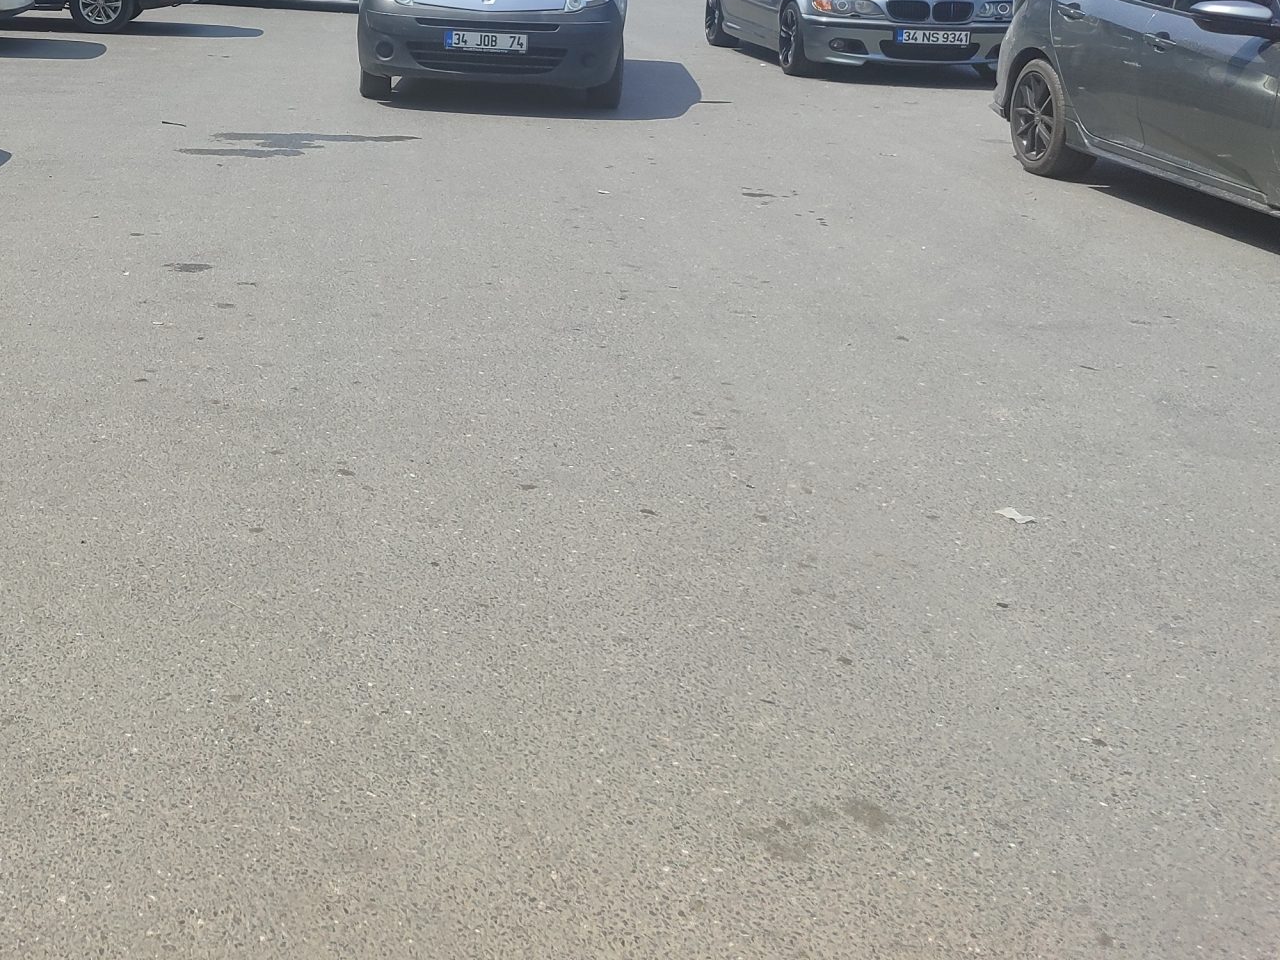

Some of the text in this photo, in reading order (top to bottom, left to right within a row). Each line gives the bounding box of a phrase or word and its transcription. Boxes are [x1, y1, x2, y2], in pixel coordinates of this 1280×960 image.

[453, 33, 524, 48] 34 JOB 74
[904, 31, 968, 43] 34 NS 9341
